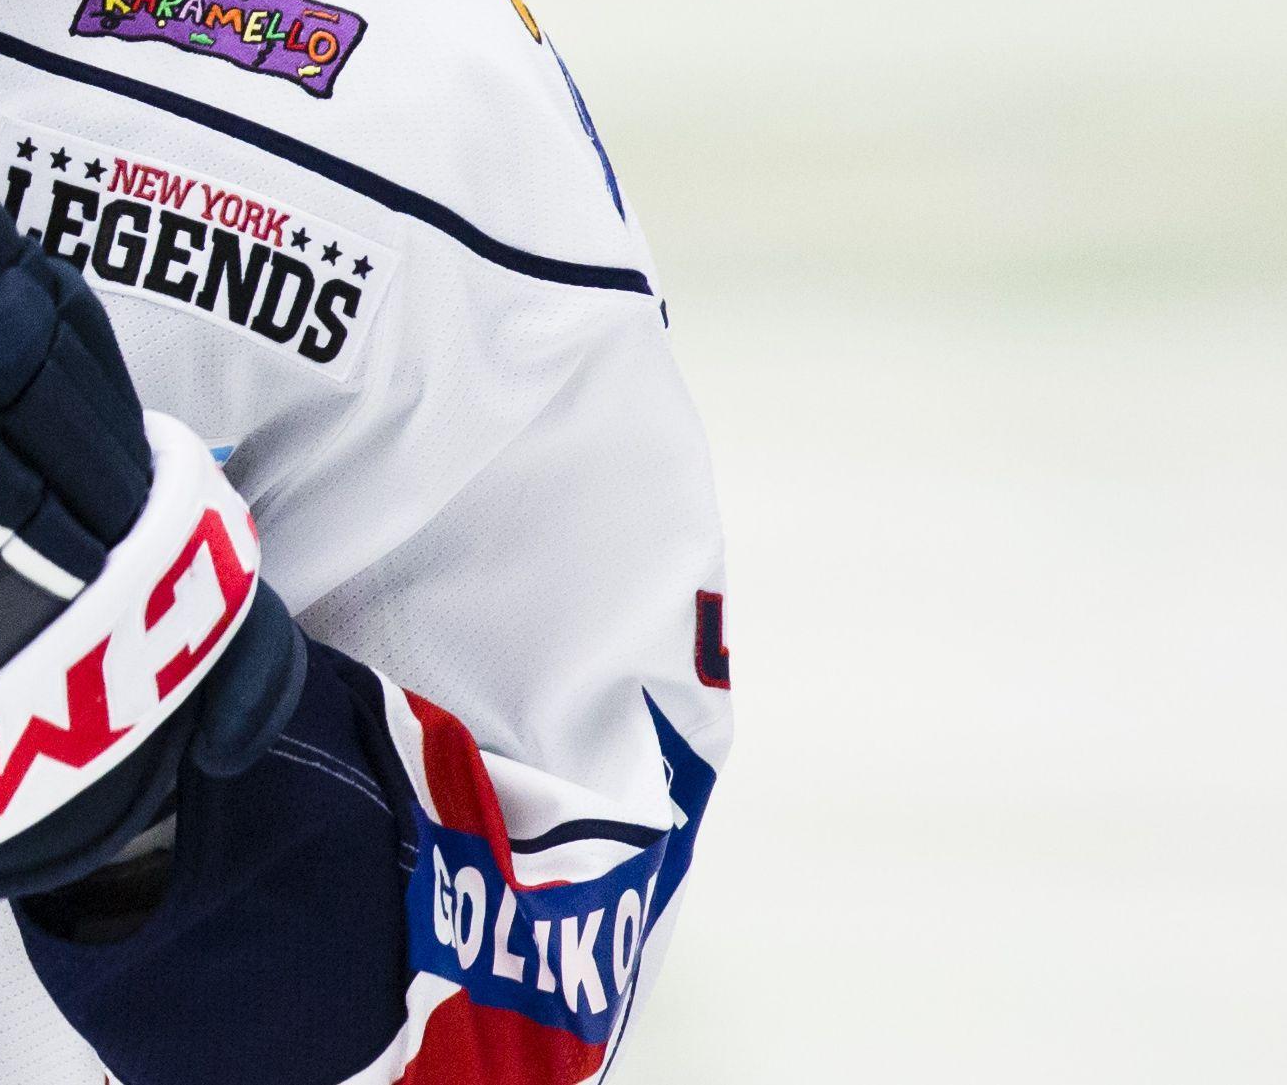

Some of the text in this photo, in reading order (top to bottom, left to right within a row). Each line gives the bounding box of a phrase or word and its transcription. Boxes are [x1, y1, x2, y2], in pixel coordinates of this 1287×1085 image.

[4, 164, 362, 364] LEGENDS
[107, 157, 290, 248] NEW YORK
[432, 844, 657, 1015] GOLIKO
